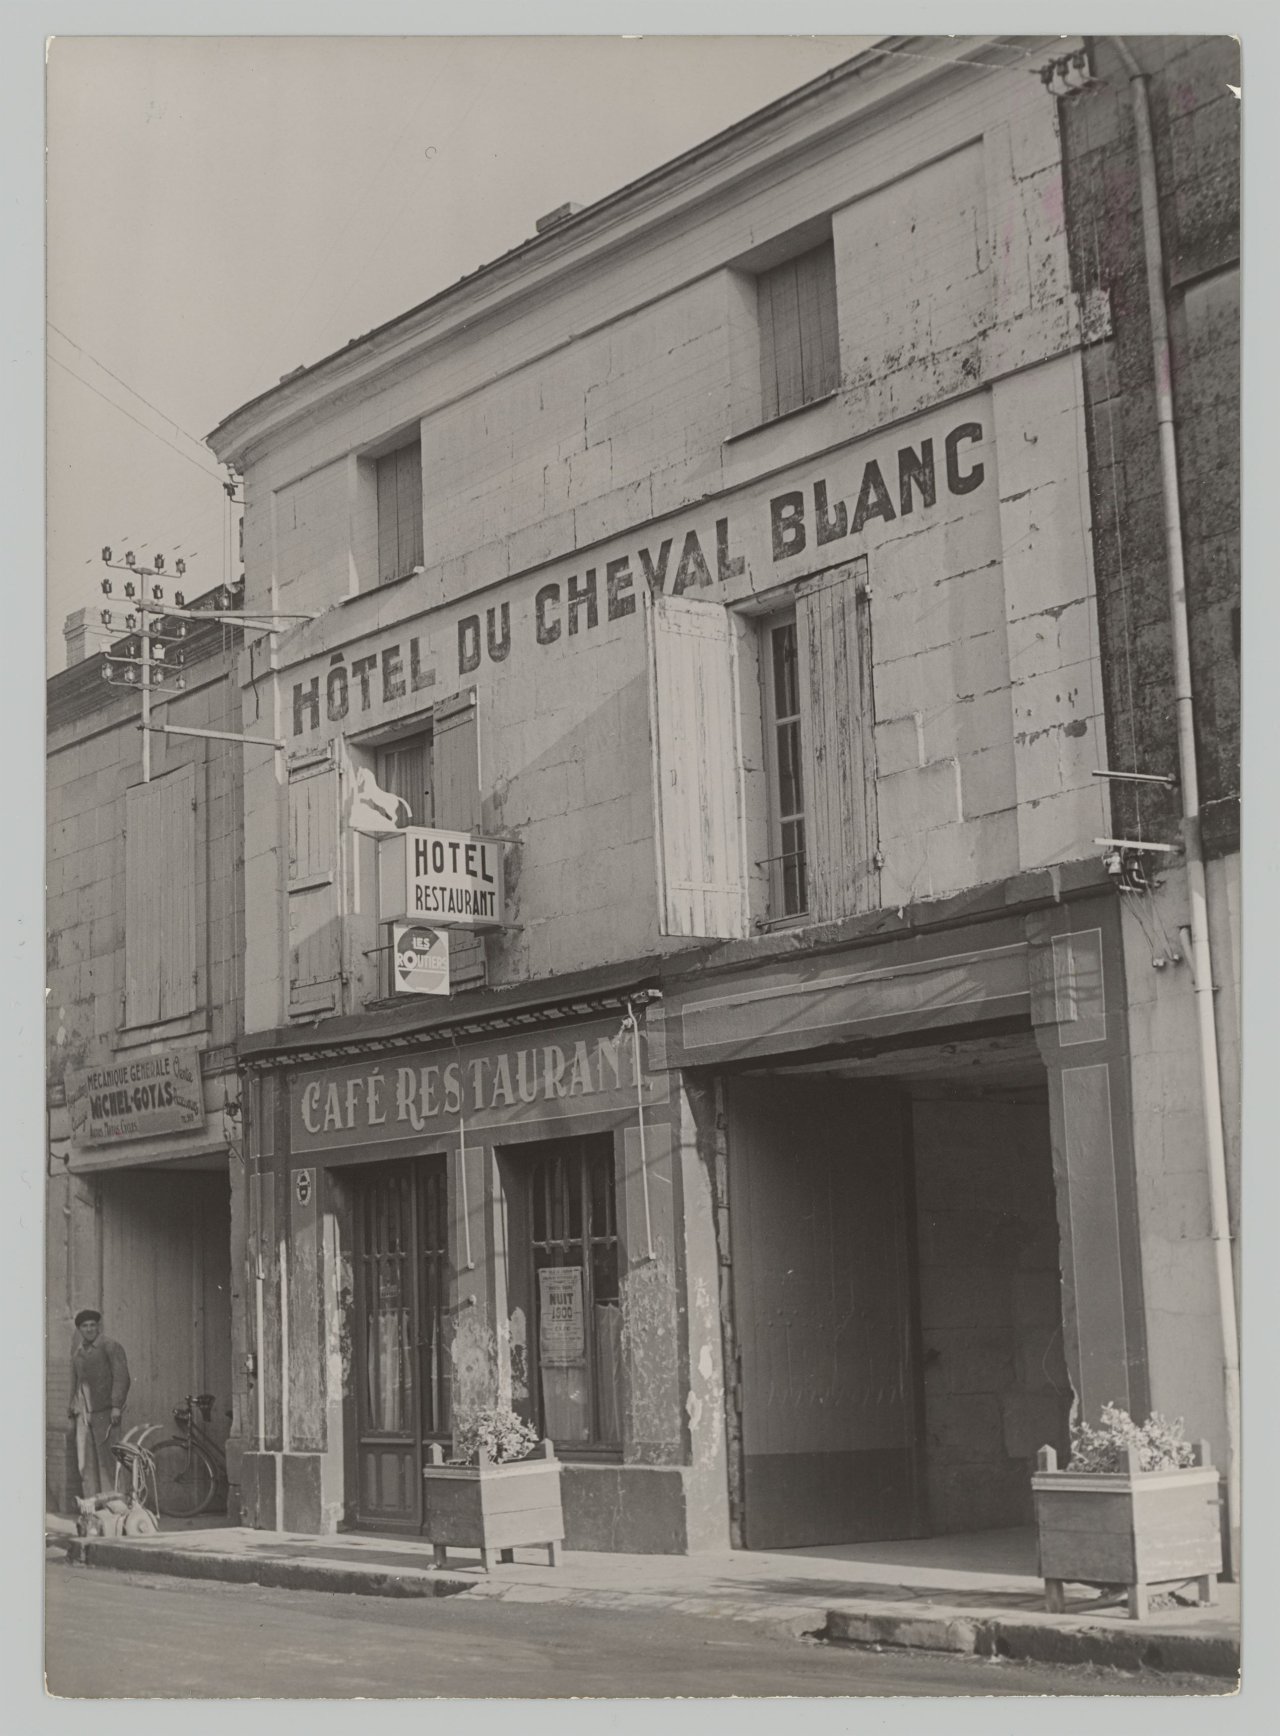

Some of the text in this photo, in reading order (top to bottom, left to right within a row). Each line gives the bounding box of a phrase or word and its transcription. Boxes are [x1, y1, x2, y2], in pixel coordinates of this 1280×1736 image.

[292, 421, 986, 736] HÔTEL DU CHEVAL BLANC
[415, 838, 494, 884] HOTEL
[415, 884, 496, 917] RESTAURANT
[412, 936, 431, 950] LES
[397, 950, 447, 970] ROUTIERS
[301, 1029, 649, 1134] CAFÉ RESTAURANT
[550, 1292, 574, 1305] NUIT
